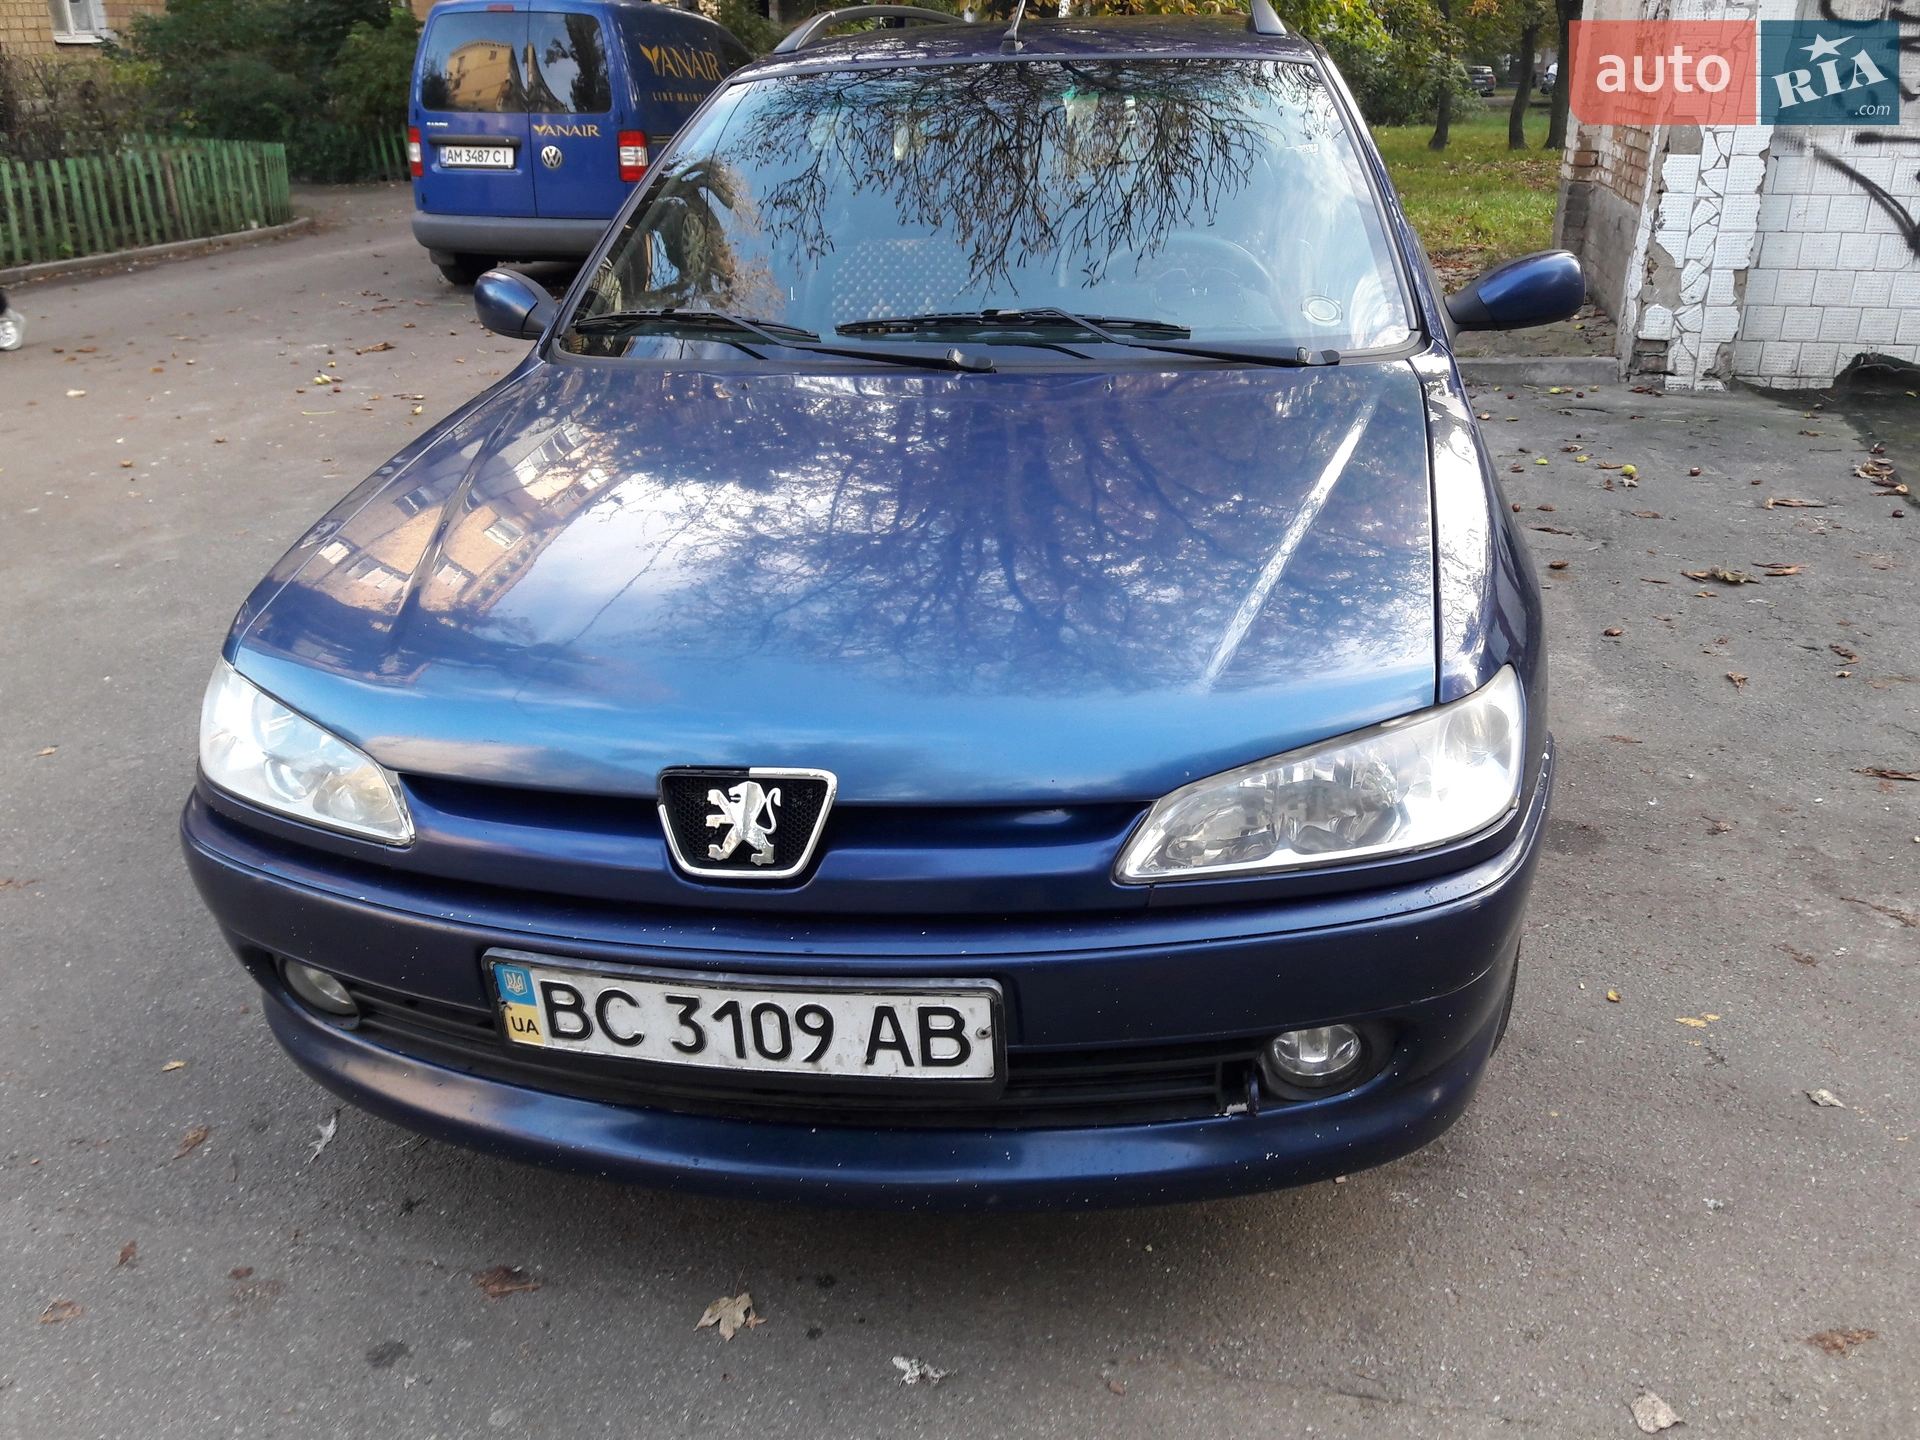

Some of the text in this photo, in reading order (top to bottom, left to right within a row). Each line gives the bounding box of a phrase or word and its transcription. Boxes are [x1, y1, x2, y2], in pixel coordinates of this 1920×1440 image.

[640, 43, 724, 81] YANAIR
[652, 91, 674, 102] LINE
[532, 124, 602, 137] YANAIR
[446, 148, 463, 163] AM
[464, 148, 490, 163] 3487
[510, 1016, 540, 1036] UA
[539, 980, 973, 1069] BC 3109 AB
